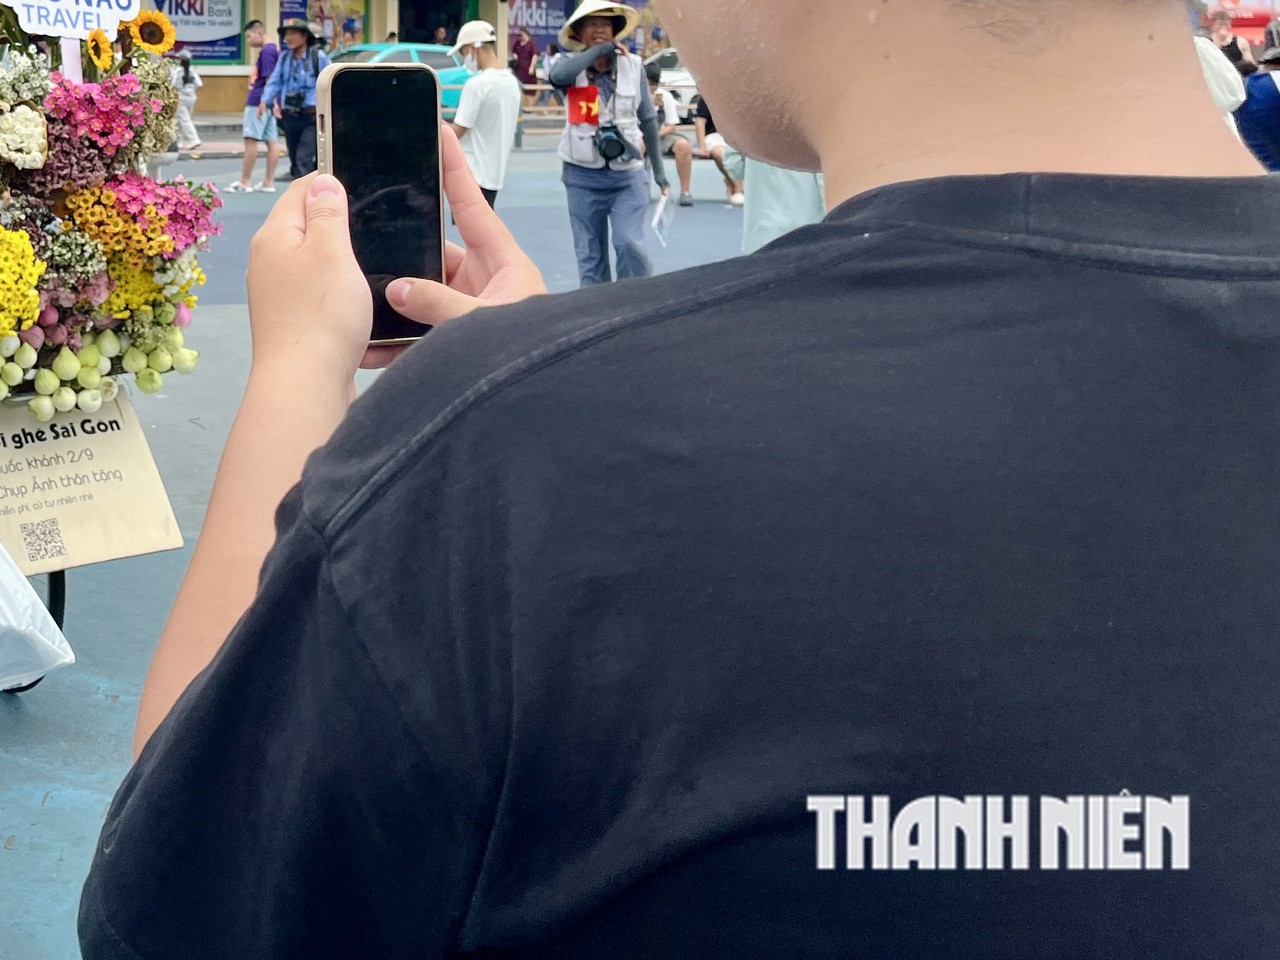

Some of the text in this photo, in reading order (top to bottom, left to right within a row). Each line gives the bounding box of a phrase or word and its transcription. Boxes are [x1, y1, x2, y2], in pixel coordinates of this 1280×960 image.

[21, 3, 109, 33] TRAVEL
[207, 6, 234, 17] Bank
[67, 448, 94, 464] 2/9
